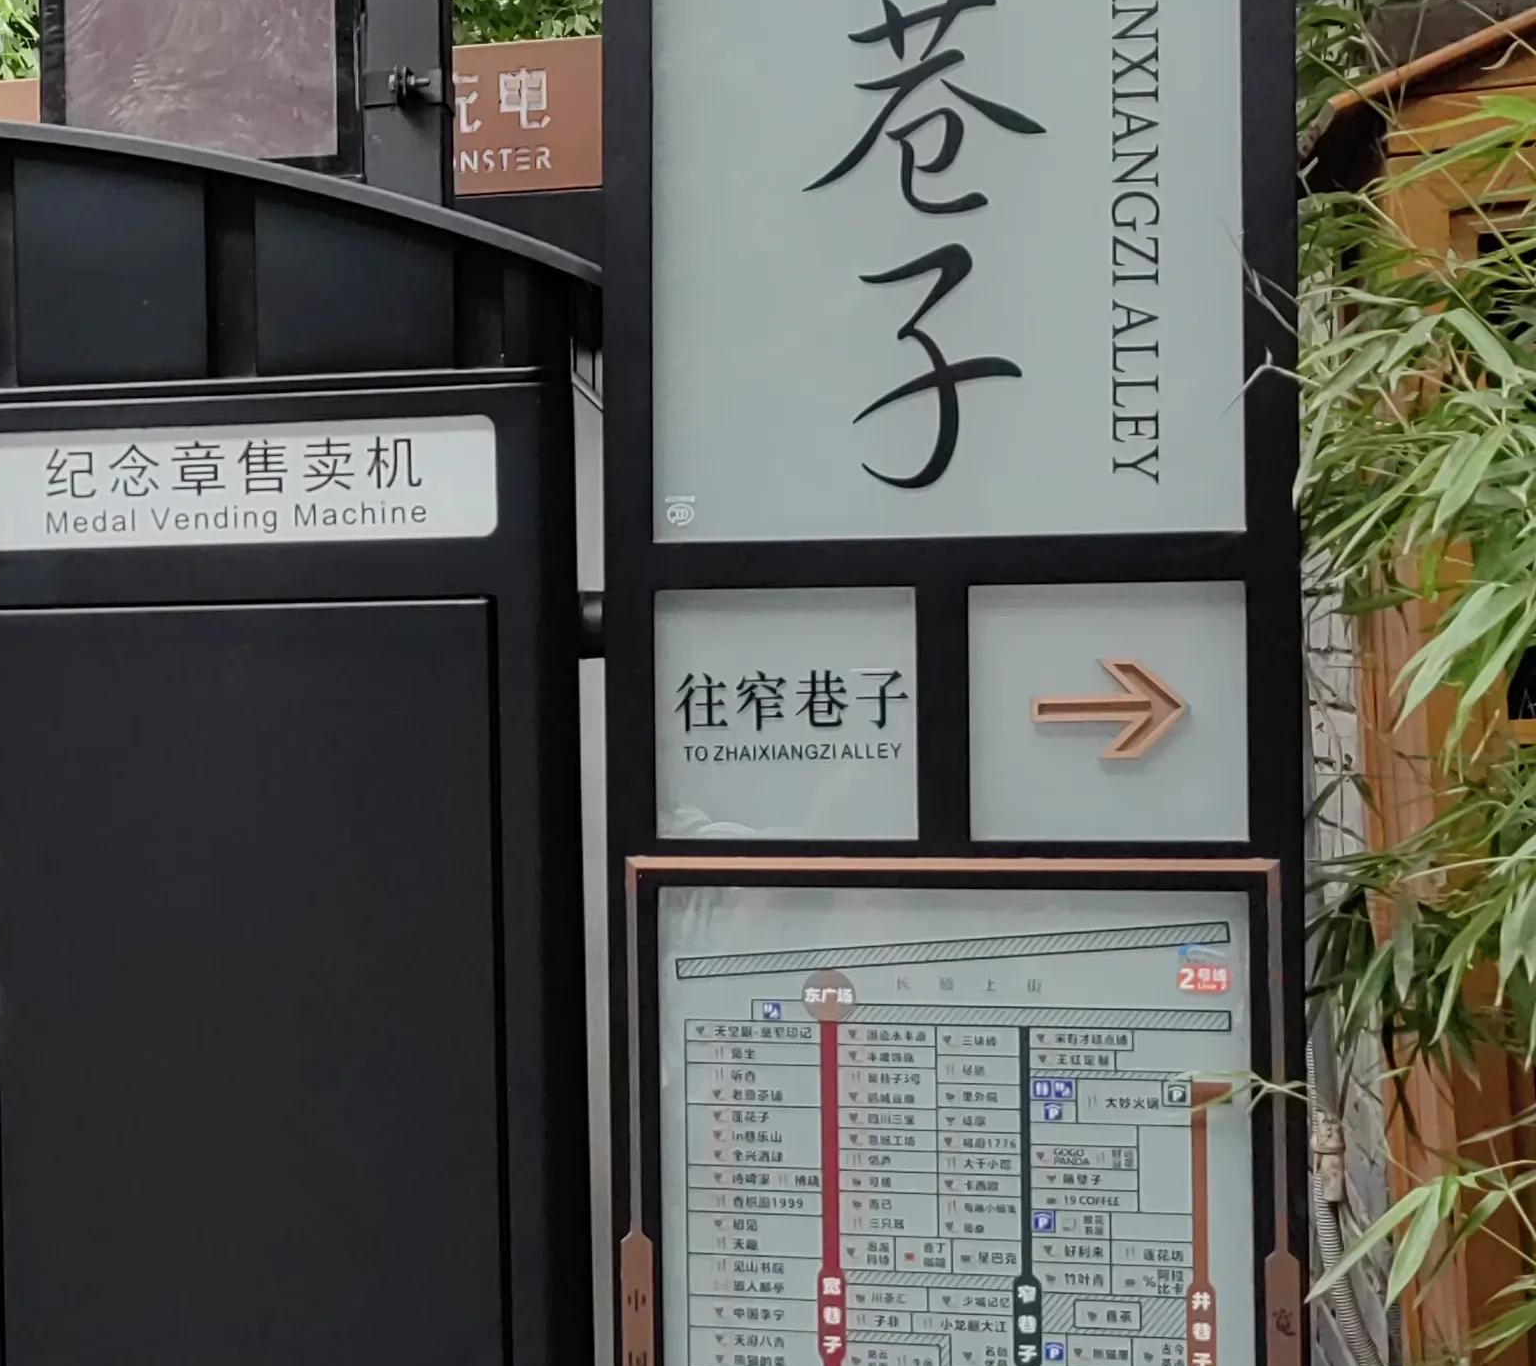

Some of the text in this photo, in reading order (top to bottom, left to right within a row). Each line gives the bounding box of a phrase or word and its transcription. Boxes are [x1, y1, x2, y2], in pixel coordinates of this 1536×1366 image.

[452, 146, 552, 173] NSTER
[1110, 300, 1160, 485] ALLEY
[45, 436, 422, 498] 纪念章售卖机
[45, 501, 428, 534] Medal Vending Machine
[675, 669, 909, 732] 往窄巷子
[684, 743, 902, 762] TO ZHAIXIANGZI ALLEY
[805, 988, 853, 1003] 东广场
[1105, 1097, 1159, 1110] 大妙火锅
[1064, 1196, 1120, 1206] 19 COFFEE
[978, 1252, 1017, 1264] 星巴克
[1065, 1245, 1104, 1258] 好利来
[733, 1308, 784, 1322] 中国李宁
